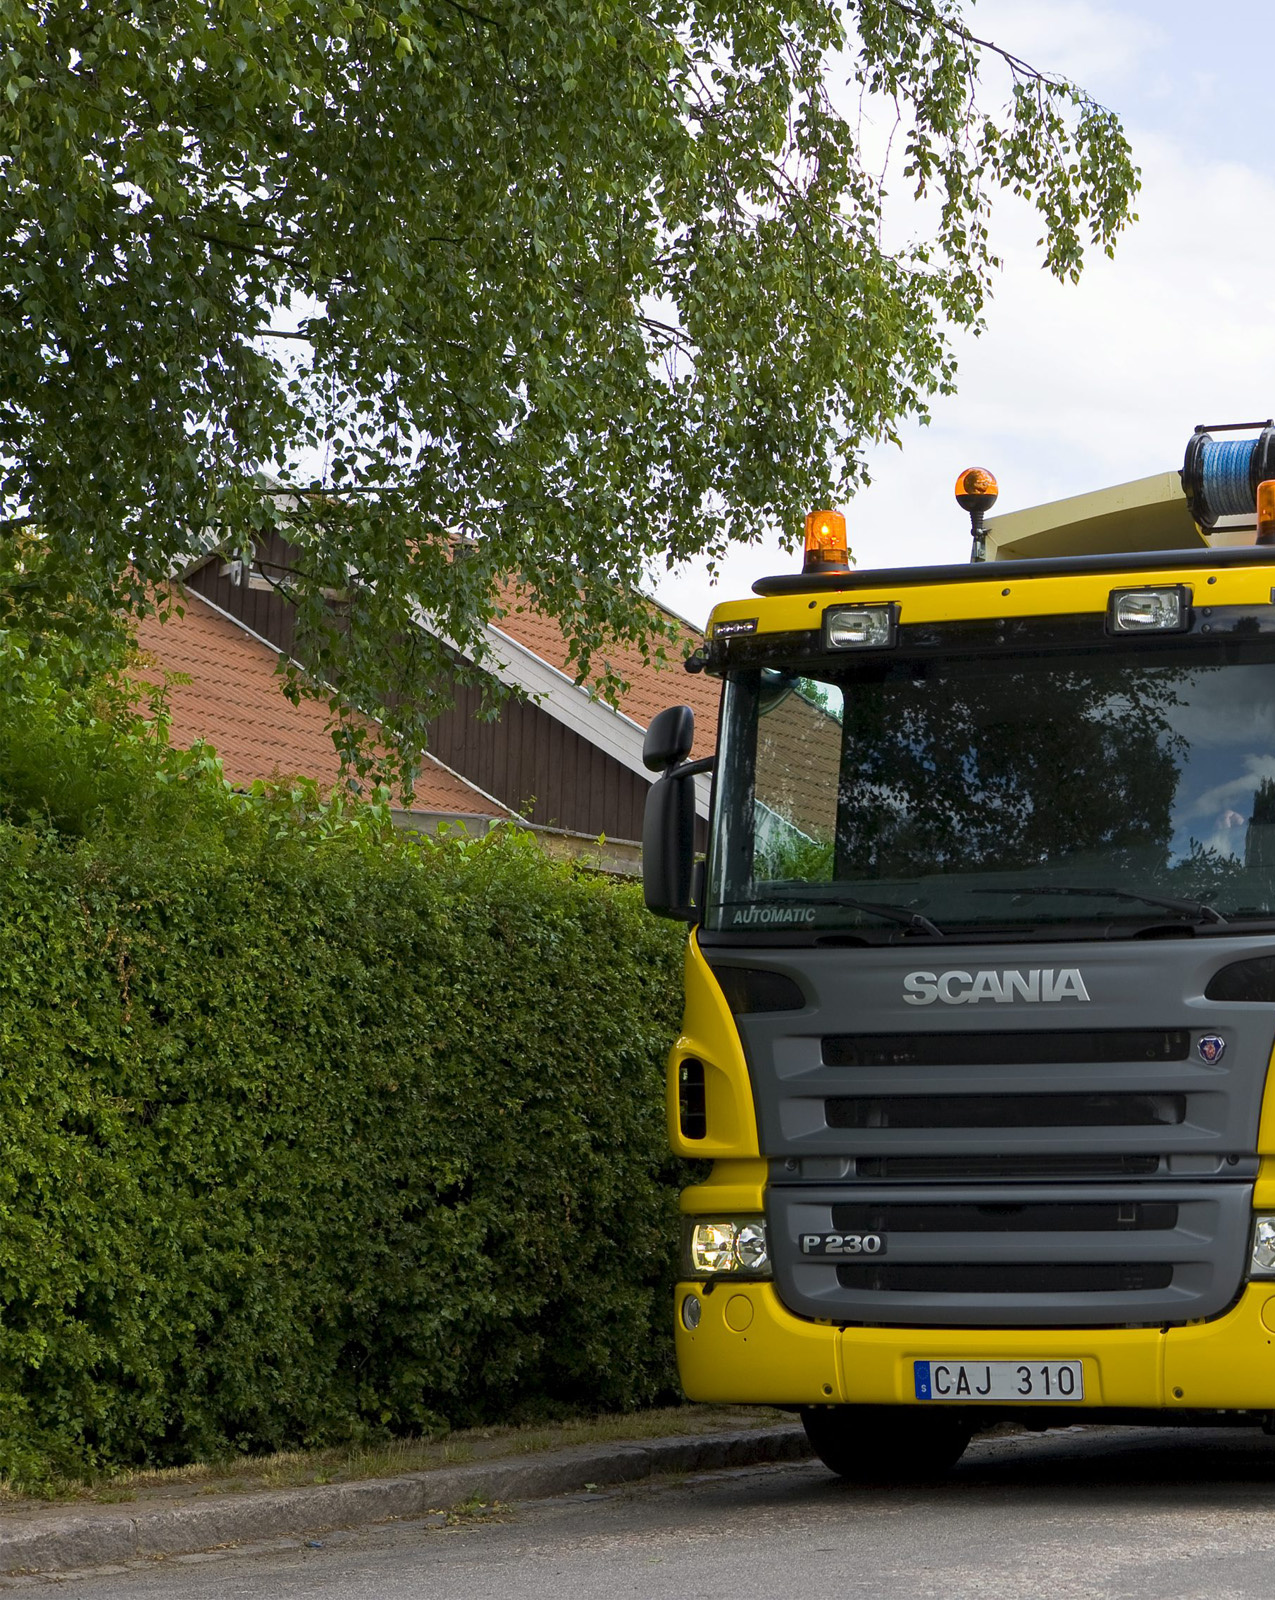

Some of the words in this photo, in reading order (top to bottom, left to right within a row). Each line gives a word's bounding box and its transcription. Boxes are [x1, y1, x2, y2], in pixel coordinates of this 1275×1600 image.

[733, 907, 816, 924] AUTOMATIC
[902, 968, 1091, 1006] SCANIA
[803, 1235, 821, 1254] P
[825, 1234, 882, 1254] 230
[920, 1384, 928, 1393] S
[934, 1366, 992, 1396] CAJ
[1016, 1366, 1075, 1396] 310
